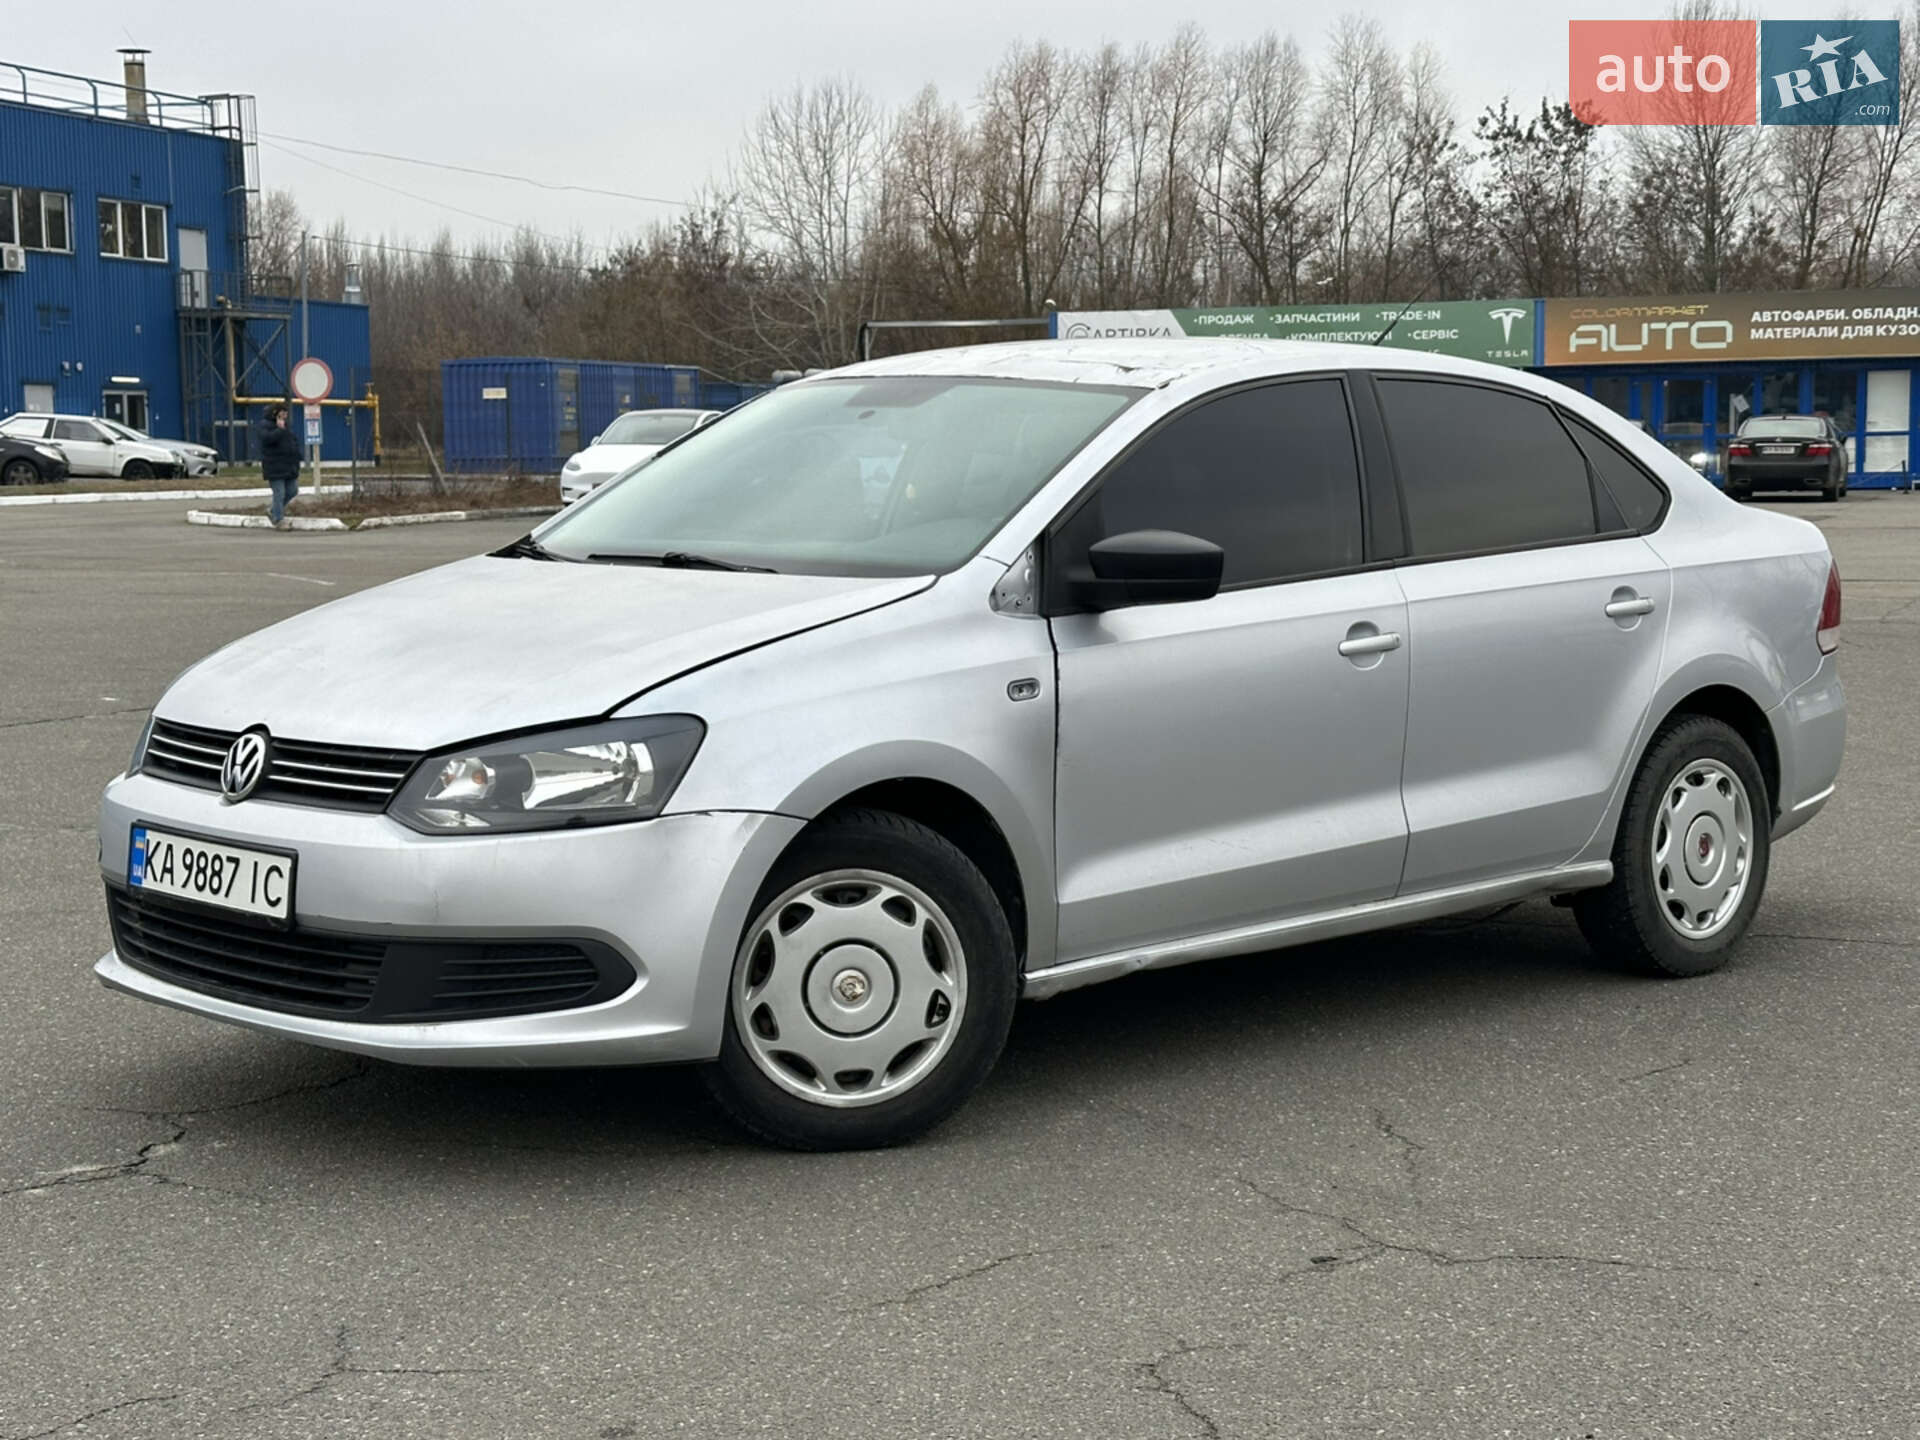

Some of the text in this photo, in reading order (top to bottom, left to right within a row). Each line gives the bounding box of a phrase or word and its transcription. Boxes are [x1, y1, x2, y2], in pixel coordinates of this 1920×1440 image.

[1198, 314, 1254, 325] ПРОДАЖ
[1274, 312, 1360, 323] ЗАПЧАСТИНИ
[1751, 307, 1920, 322] АВТОФАРБИ. ОБЛАДН
[1412, 329, 1459, 340] СЕРВІС
[1570, 320, 1733, 352] AUTO
[1750, 324, 1920, 339] МАТЕРІАЛИ ДЛЯ КУЗО
[1486, 349, 1529, 358] TESLA
[144, 838, 284, 908] KA 9887 IC
